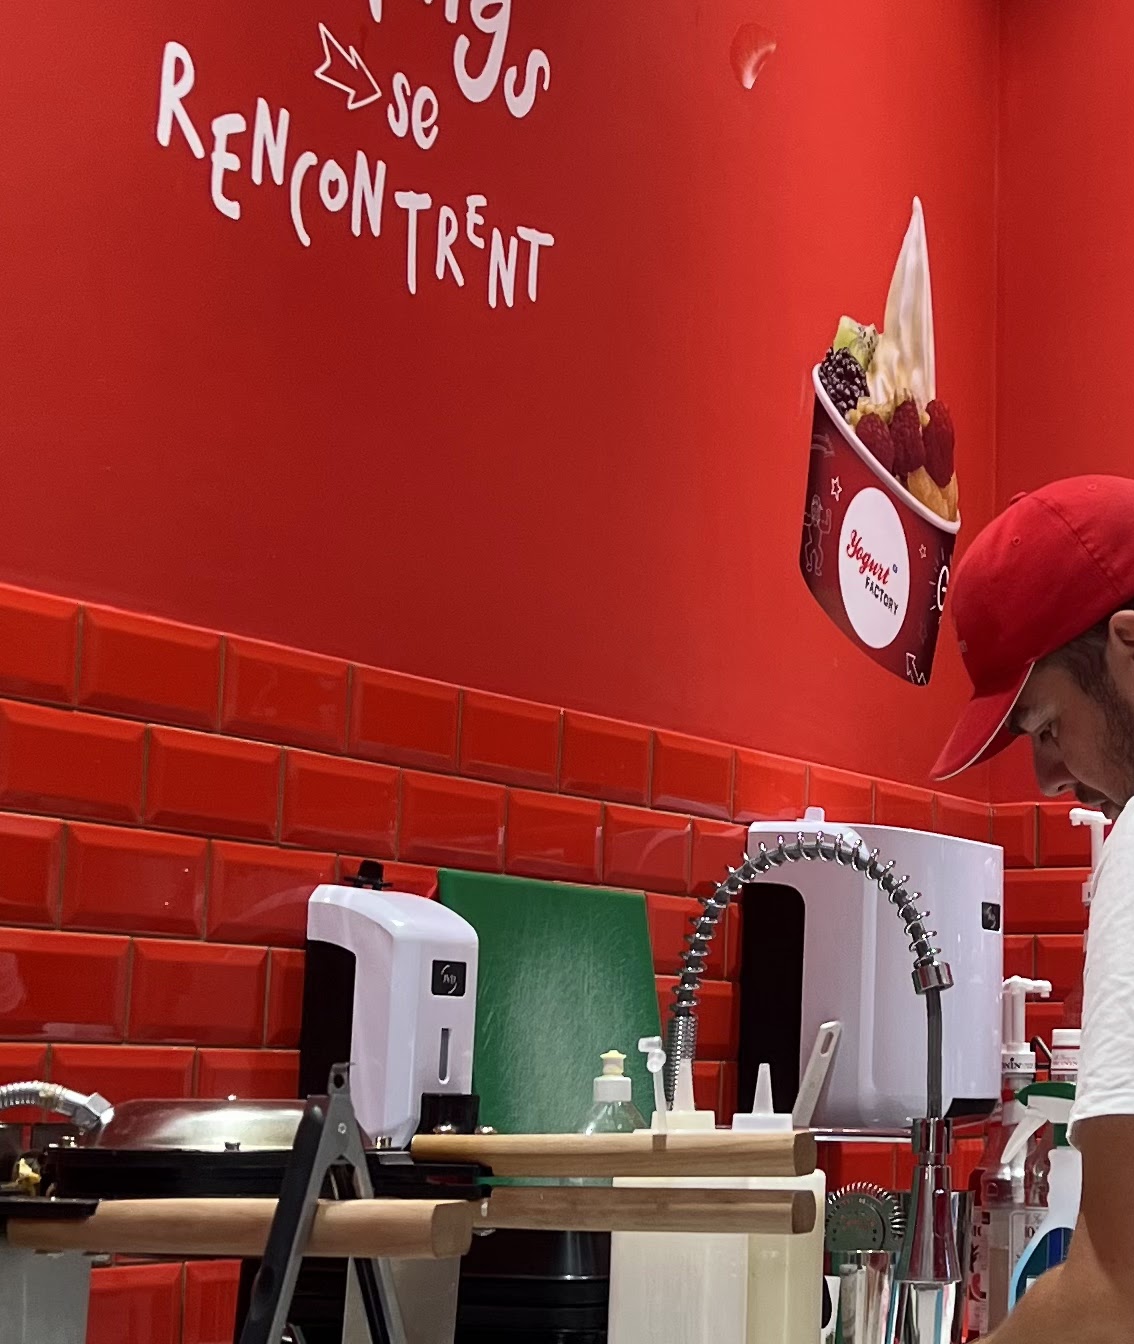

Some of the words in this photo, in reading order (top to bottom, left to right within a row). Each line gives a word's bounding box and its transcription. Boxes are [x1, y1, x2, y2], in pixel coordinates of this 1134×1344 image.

[386, 71, 440, 151] se
[155, 39, 556, 309] RENCONTRENT
[846, 529, 890, 585] Yogurt
[865, 575, 899, 616] FACTORY
